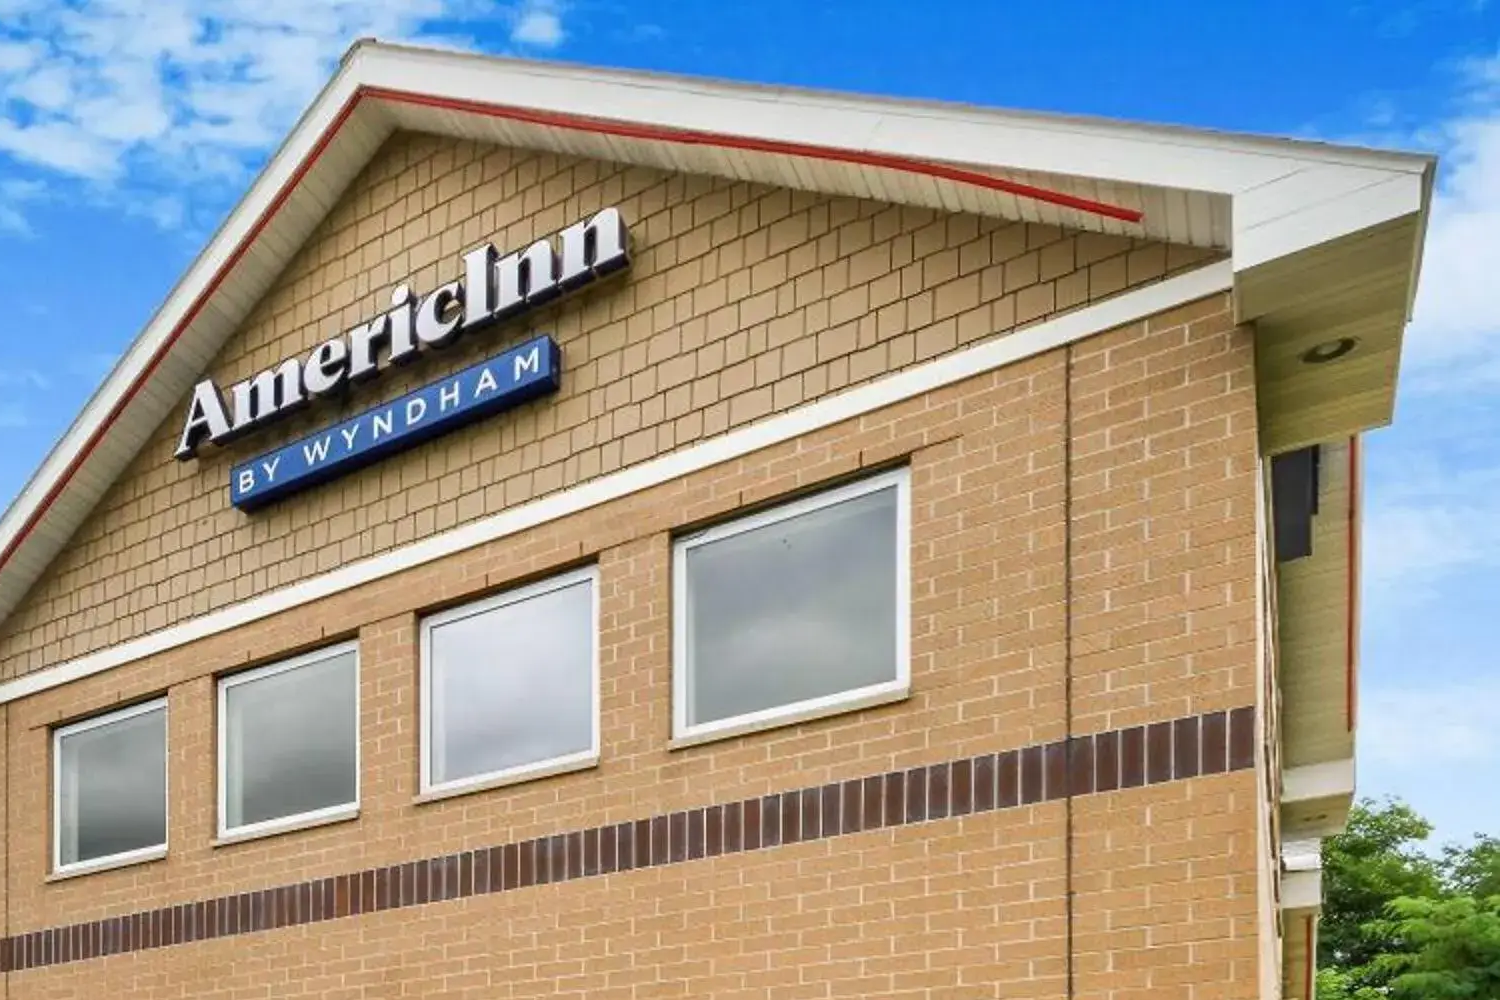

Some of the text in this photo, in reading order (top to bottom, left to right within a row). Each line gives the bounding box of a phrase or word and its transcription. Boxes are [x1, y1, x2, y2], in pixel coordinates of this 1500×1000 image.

[174, 206, 629, 459] AmericInn
[238, 347, 541, 494] BY WYNDHAM
